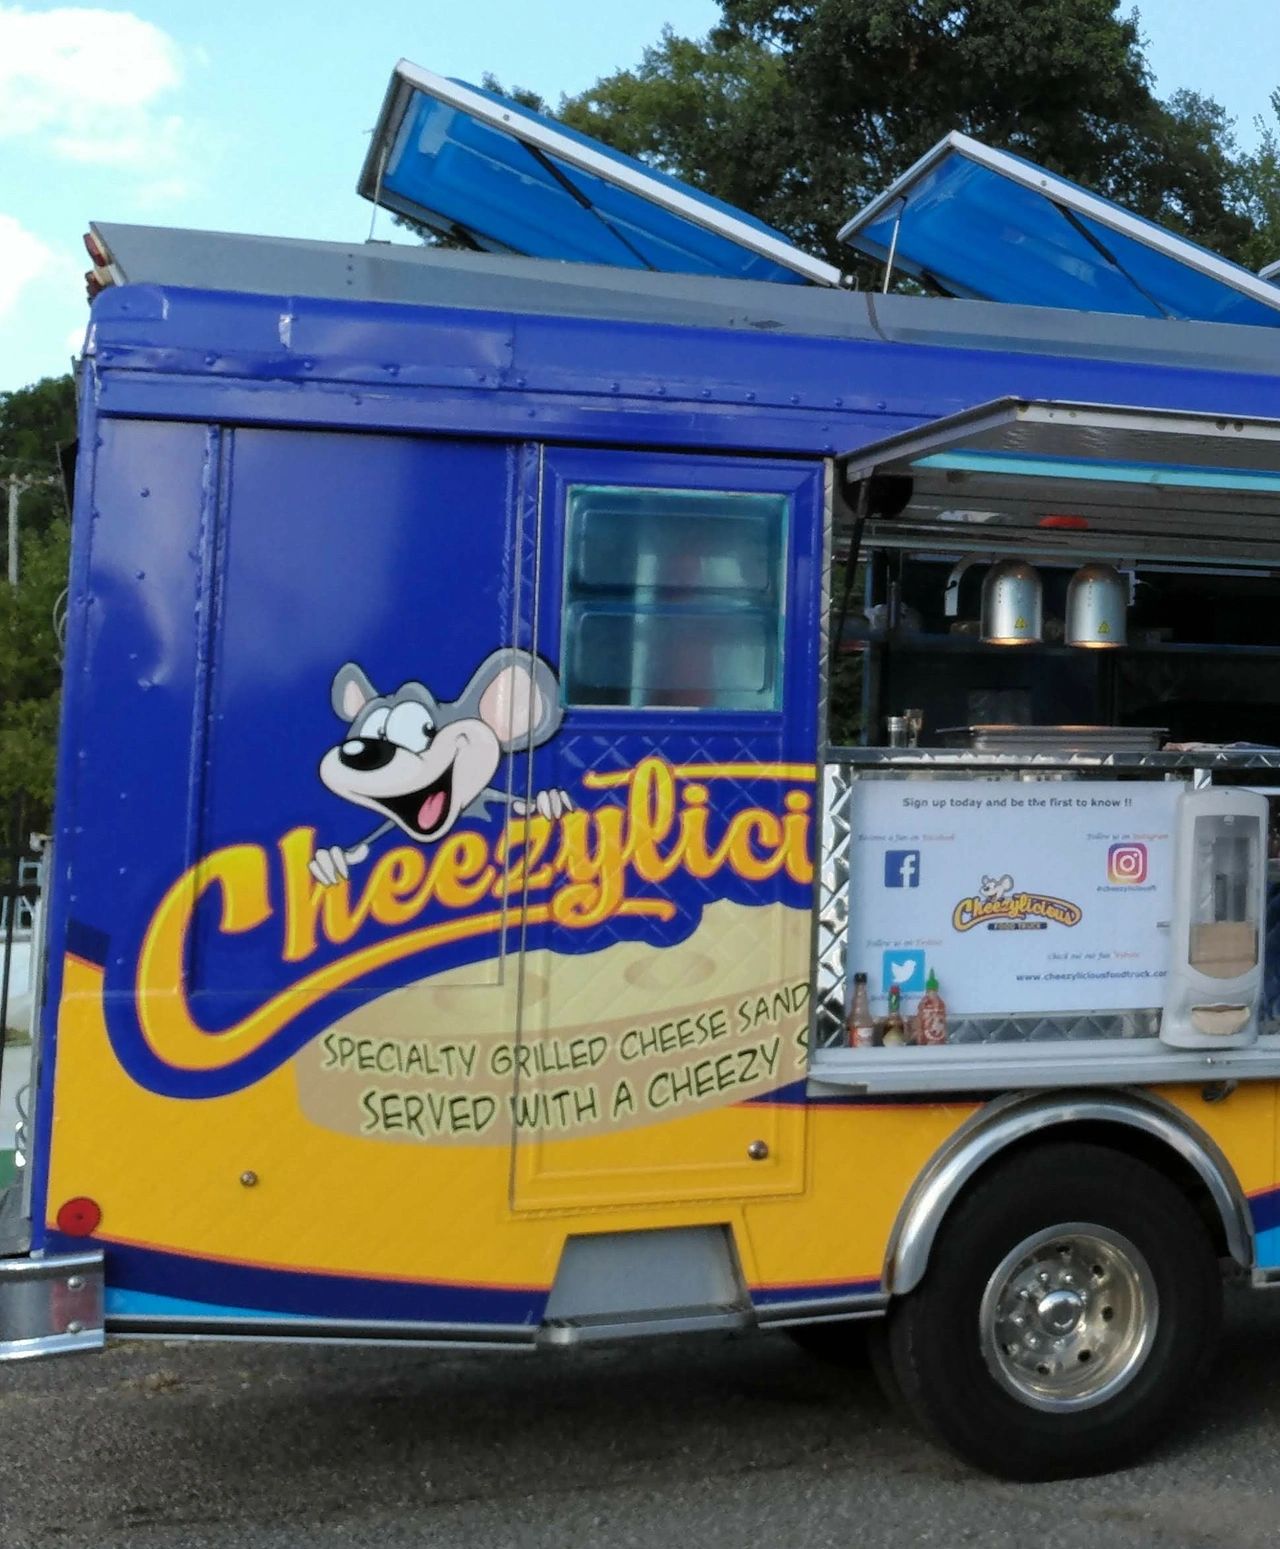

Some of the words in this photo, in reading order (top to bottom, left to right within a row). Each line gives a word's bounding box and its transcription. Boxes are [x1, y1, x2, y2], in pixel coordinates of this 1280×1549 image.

[902, 798, 928, 808] Sign
[932, 799, 946, 808] up
[950, 798, 981, 808] today
[986, 798, 1007, 807] and
[1010, 798, 1024, 807] be
[1028, 798, 1046, 807] the
[1050, 798, 1072, 807] first
[1076, 799, 1087, 807] to
[1091, 798, 1120, 807] know
[1124, 798, 1132, 807] !!
[951, 891, 1083, 933] Cheezylicious
[323, 1033, 476, 1077] SPECIALTY
[491, 1036, 608, 1078] GRILLED
[620, 1009, 727, 1060] CHEESE
[363, 1090, 496, 1136] SERVED
[510, 1087, 597, 1127] WITH
[613, 1081, 633, 1118] A
[648, 1037, 780, 1108] CHEEZY
